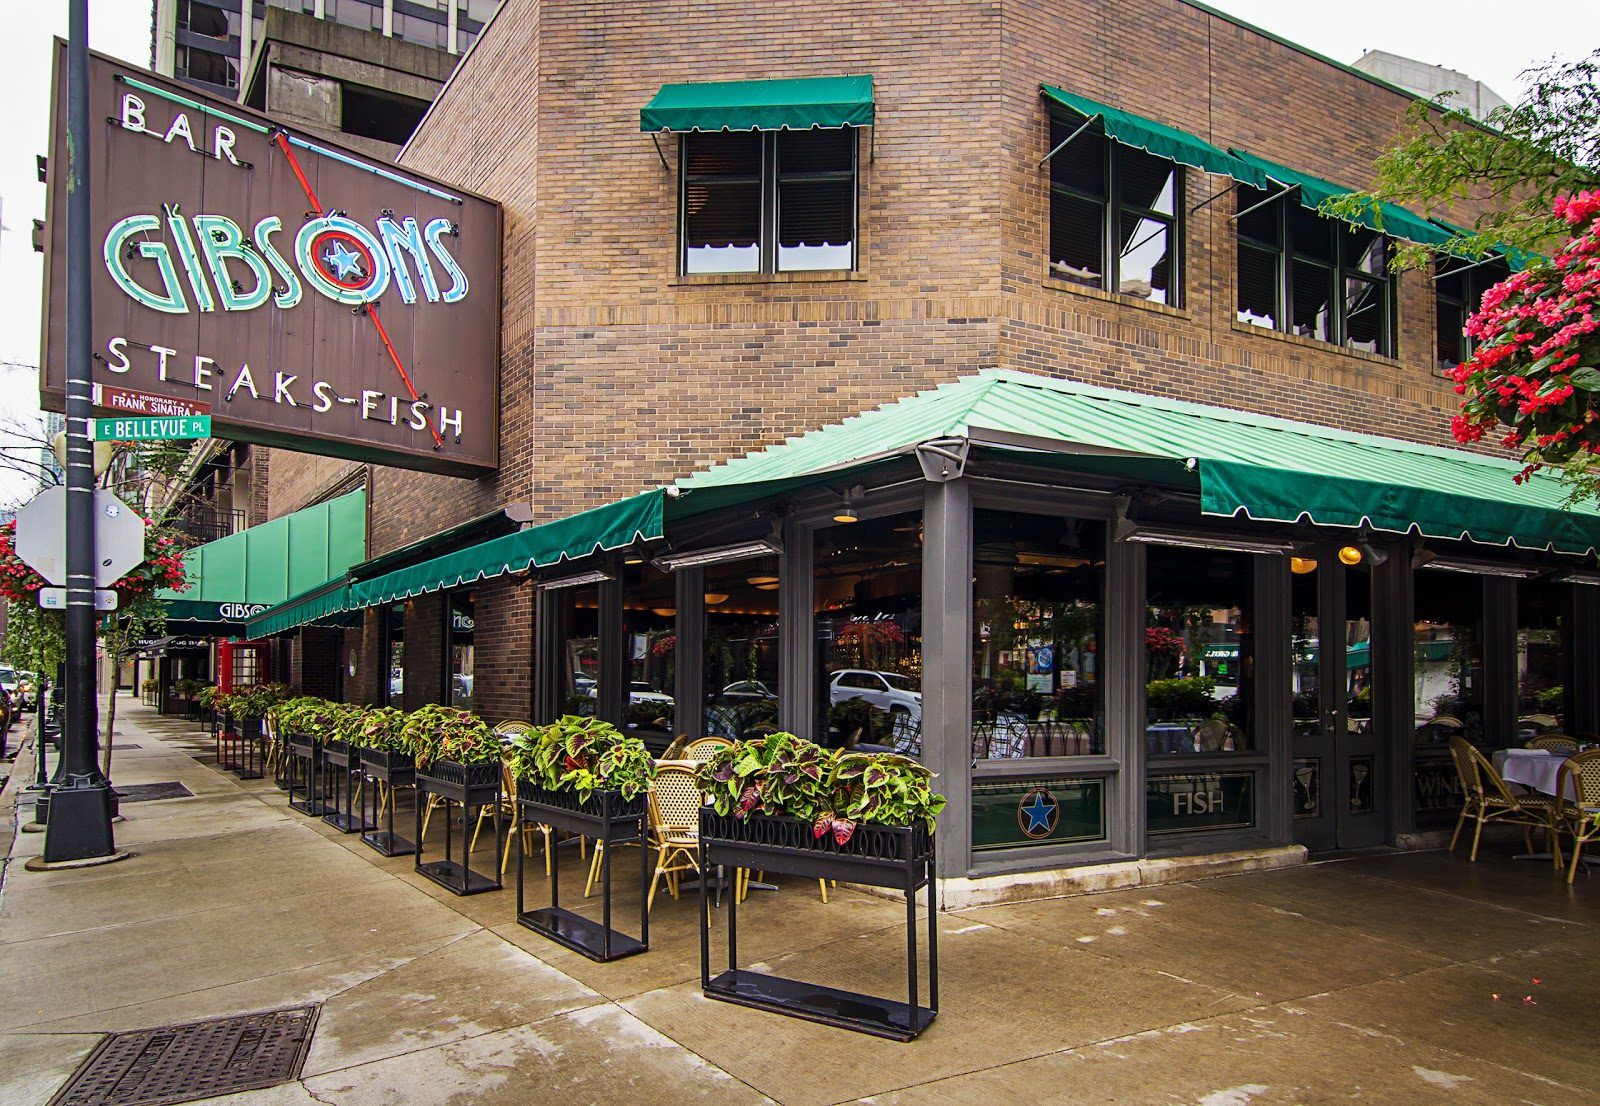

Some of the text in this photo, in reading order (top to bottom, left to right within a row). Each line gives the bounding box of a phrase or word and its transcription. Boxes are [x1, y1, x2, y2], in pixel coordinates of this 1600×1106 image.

[121, 94, 240, 165] BAR
[104, 207, 469, 313] GIBSONS
[112, 395, 146, 411] FRANK
[151, 402, 191, 416] SINATRA
[139, 394, 178, 406] HONORARY
[104, 419, 205, 437] E BELLEVUE PL
[219, 603, 272, 618] GIBSO
[1173, 790, 1224, 816] FISH
